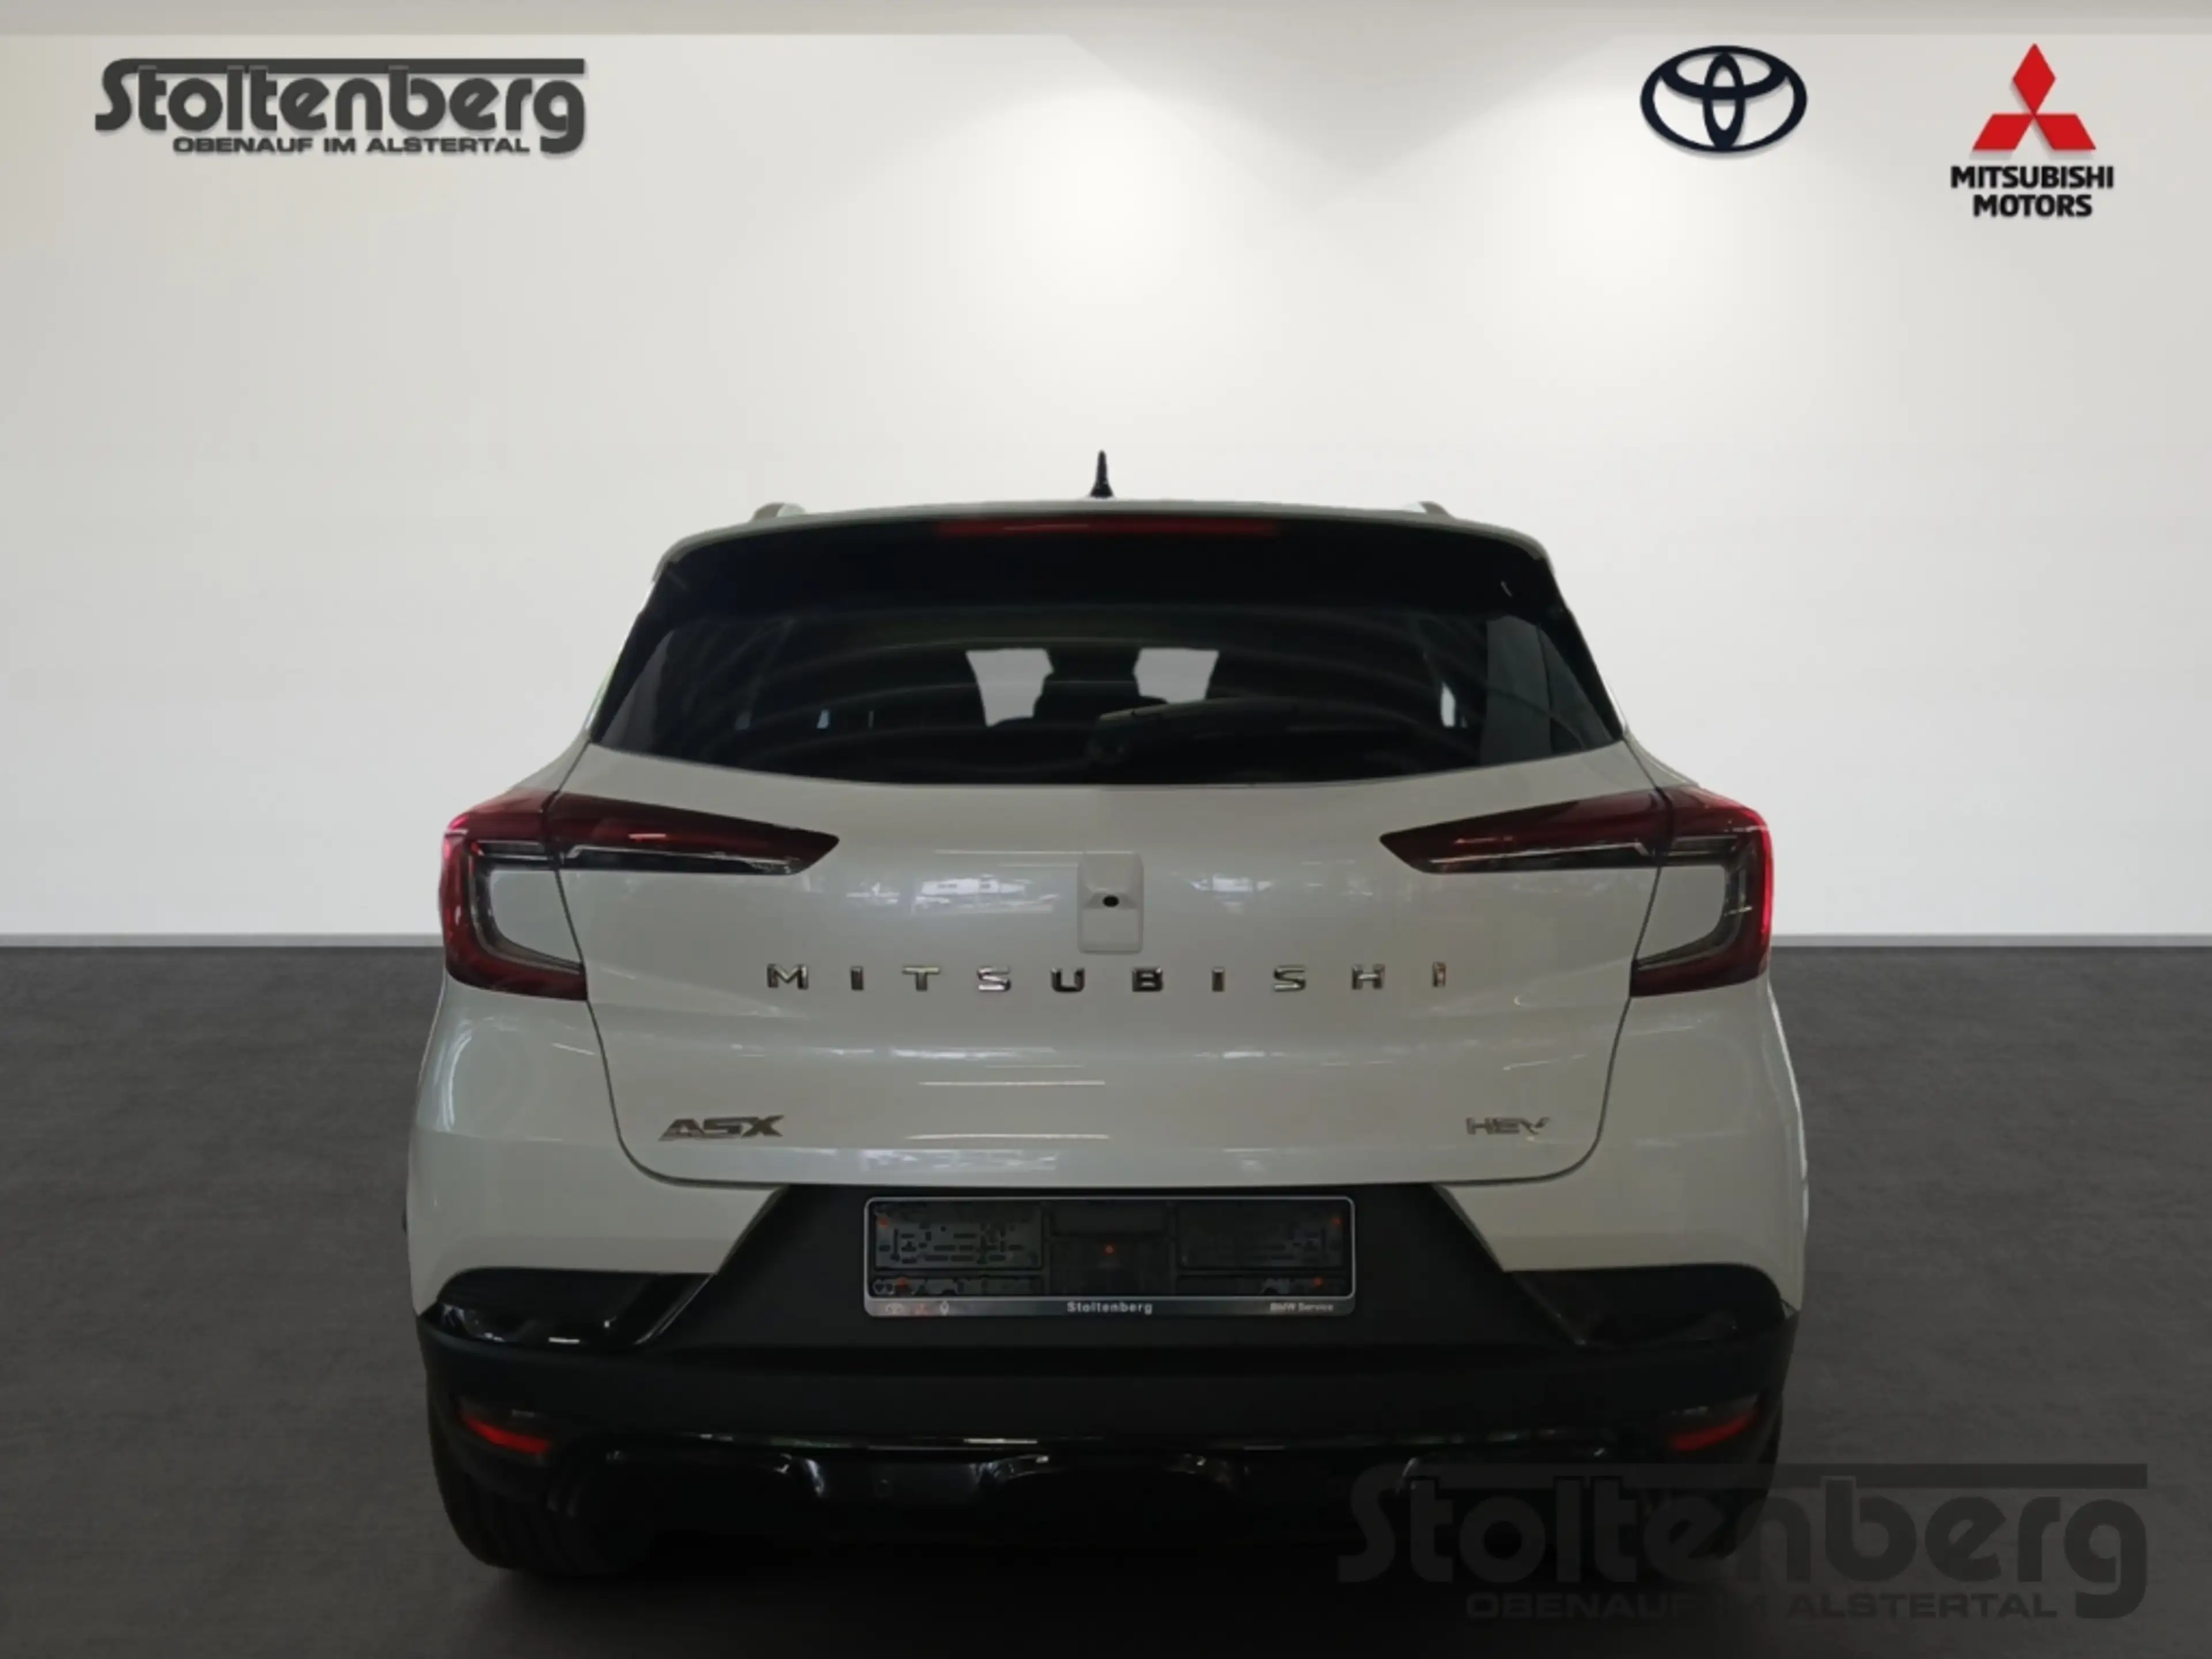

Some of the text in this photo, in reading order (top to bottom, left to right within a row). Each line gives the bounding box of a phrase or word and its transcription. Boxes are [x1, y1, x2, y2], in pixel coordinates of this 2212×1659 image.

[767, 963, 1447, 993] MITSUBISHI
[658, 1115, 784, 1141] ASX
[1466, 1116, 1550, 1135] HEV
[1067, 1301, 1153, 1315] Stoltenberg
